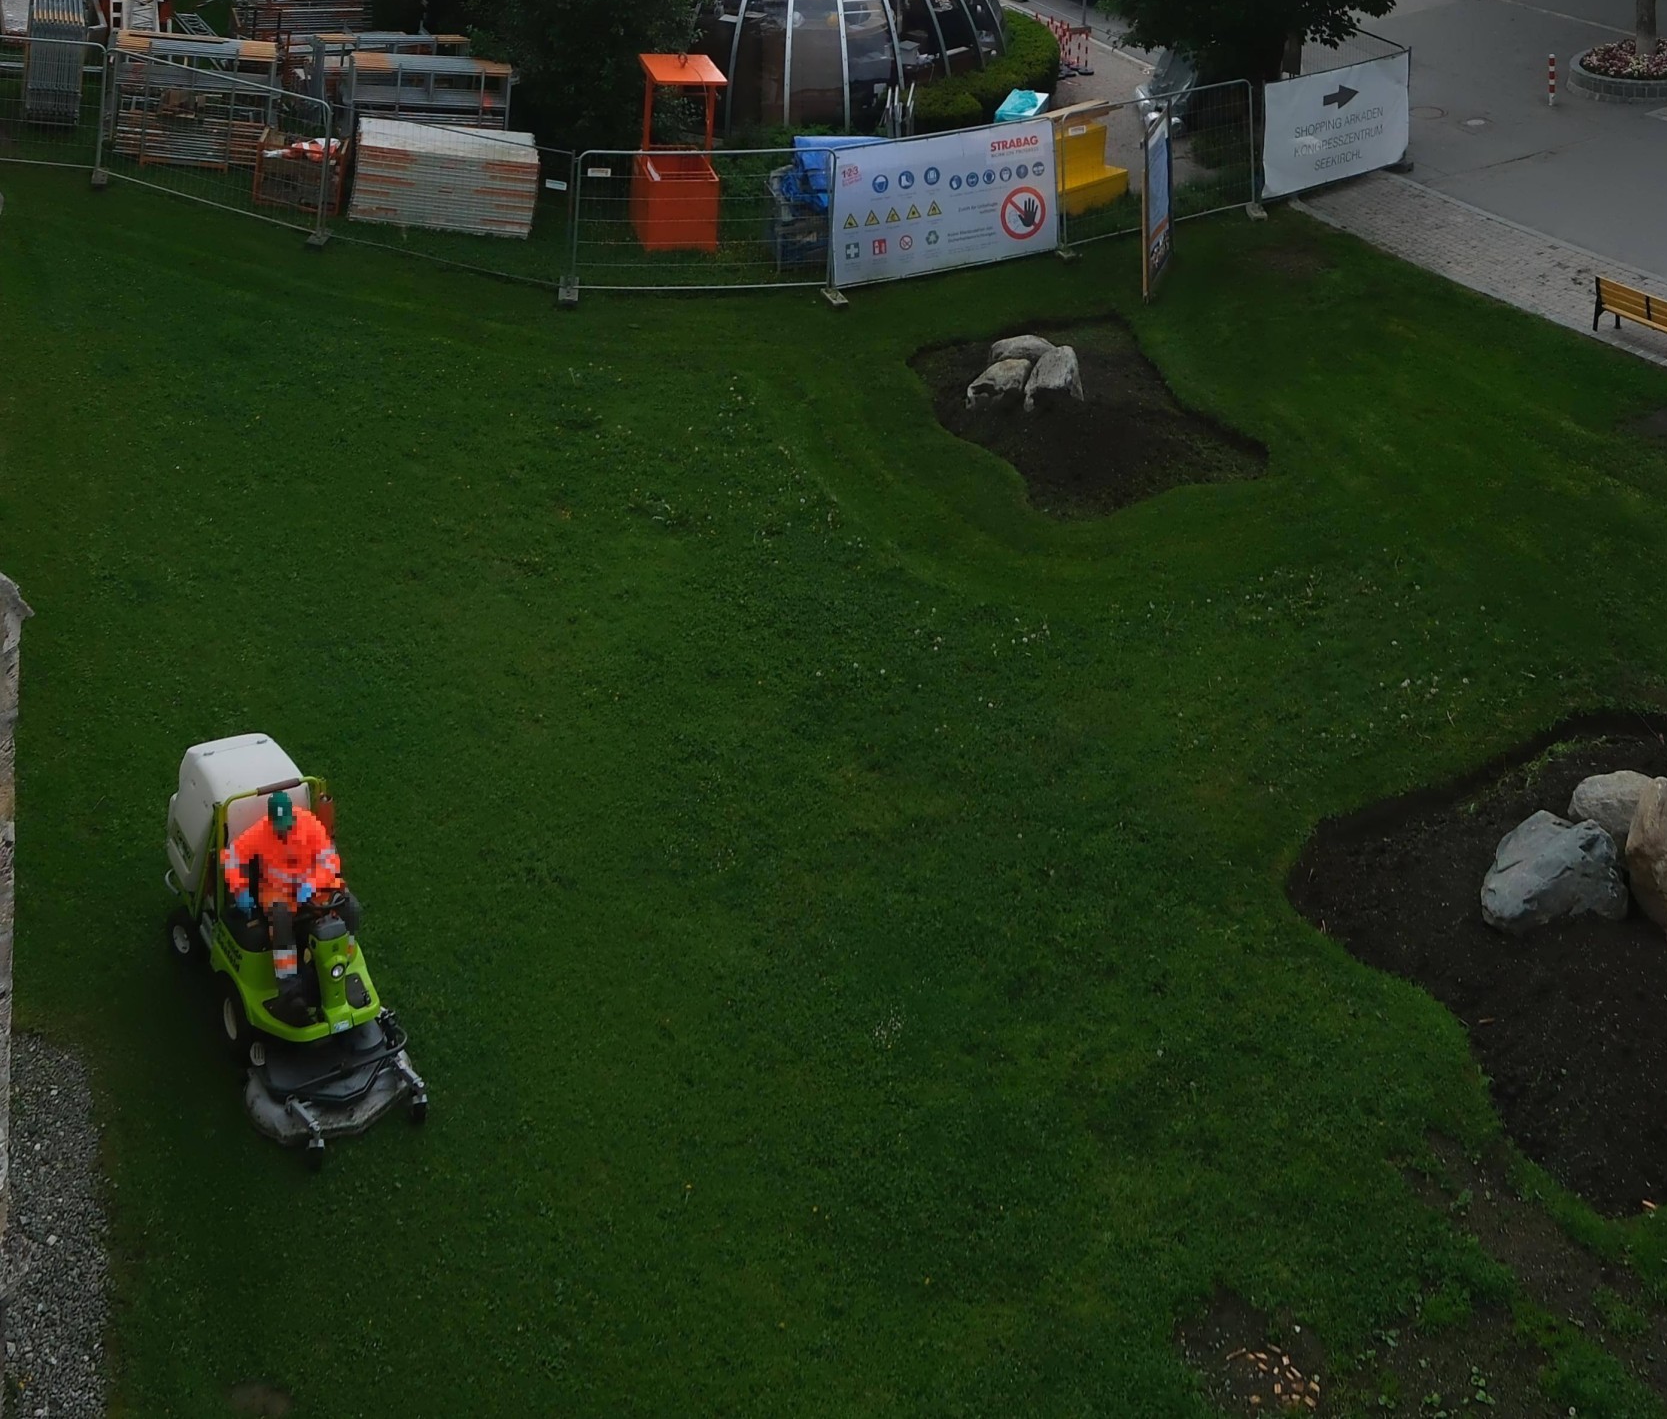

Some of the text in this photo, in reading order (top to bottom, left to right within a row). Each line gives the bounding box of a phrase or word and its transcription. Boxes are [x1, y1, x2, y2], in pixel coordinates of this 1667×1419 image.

[1294, 106, 1385, 140] SHOPPING ARKADEN
[990, 135, 1039, 152] STRABAG
[1314, 149, 1364, 171] SEEKIRCHL
